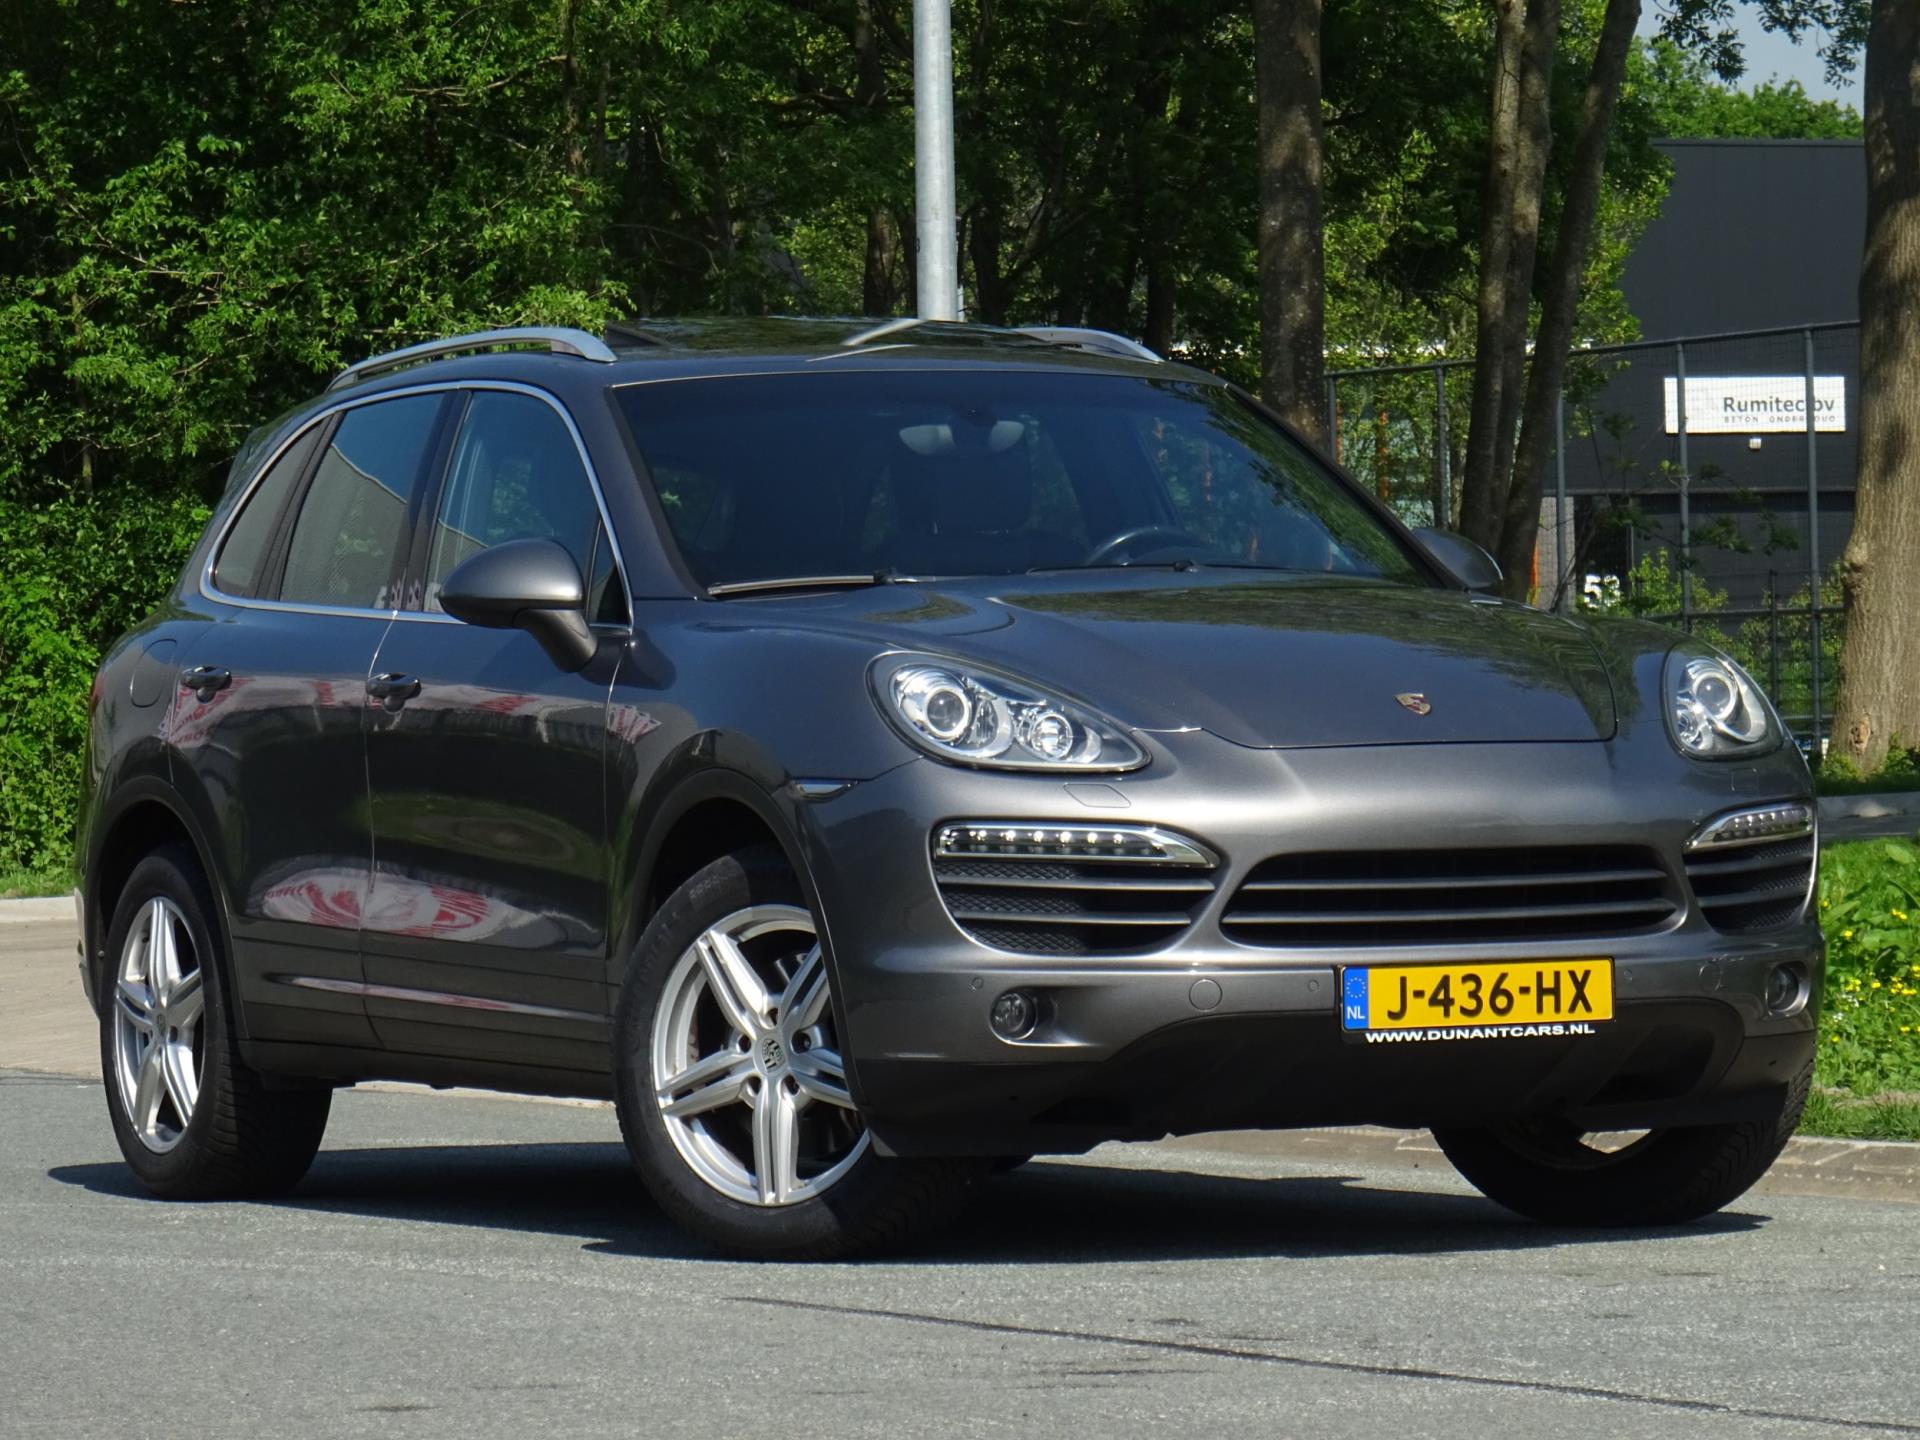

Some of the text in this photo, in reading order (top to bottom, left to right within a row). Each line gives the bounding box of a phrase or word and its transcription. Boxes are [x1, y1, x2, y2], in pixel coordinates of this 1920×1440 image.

[1723, 396, 1805, 412] Rumitec
[1387, 969, 1593, 1021] J-436-HX
[1346, 1005, 1366, 1020] NL
[1365, 1023, 1596, 1043] WWW.DUNANTCARS.NL
